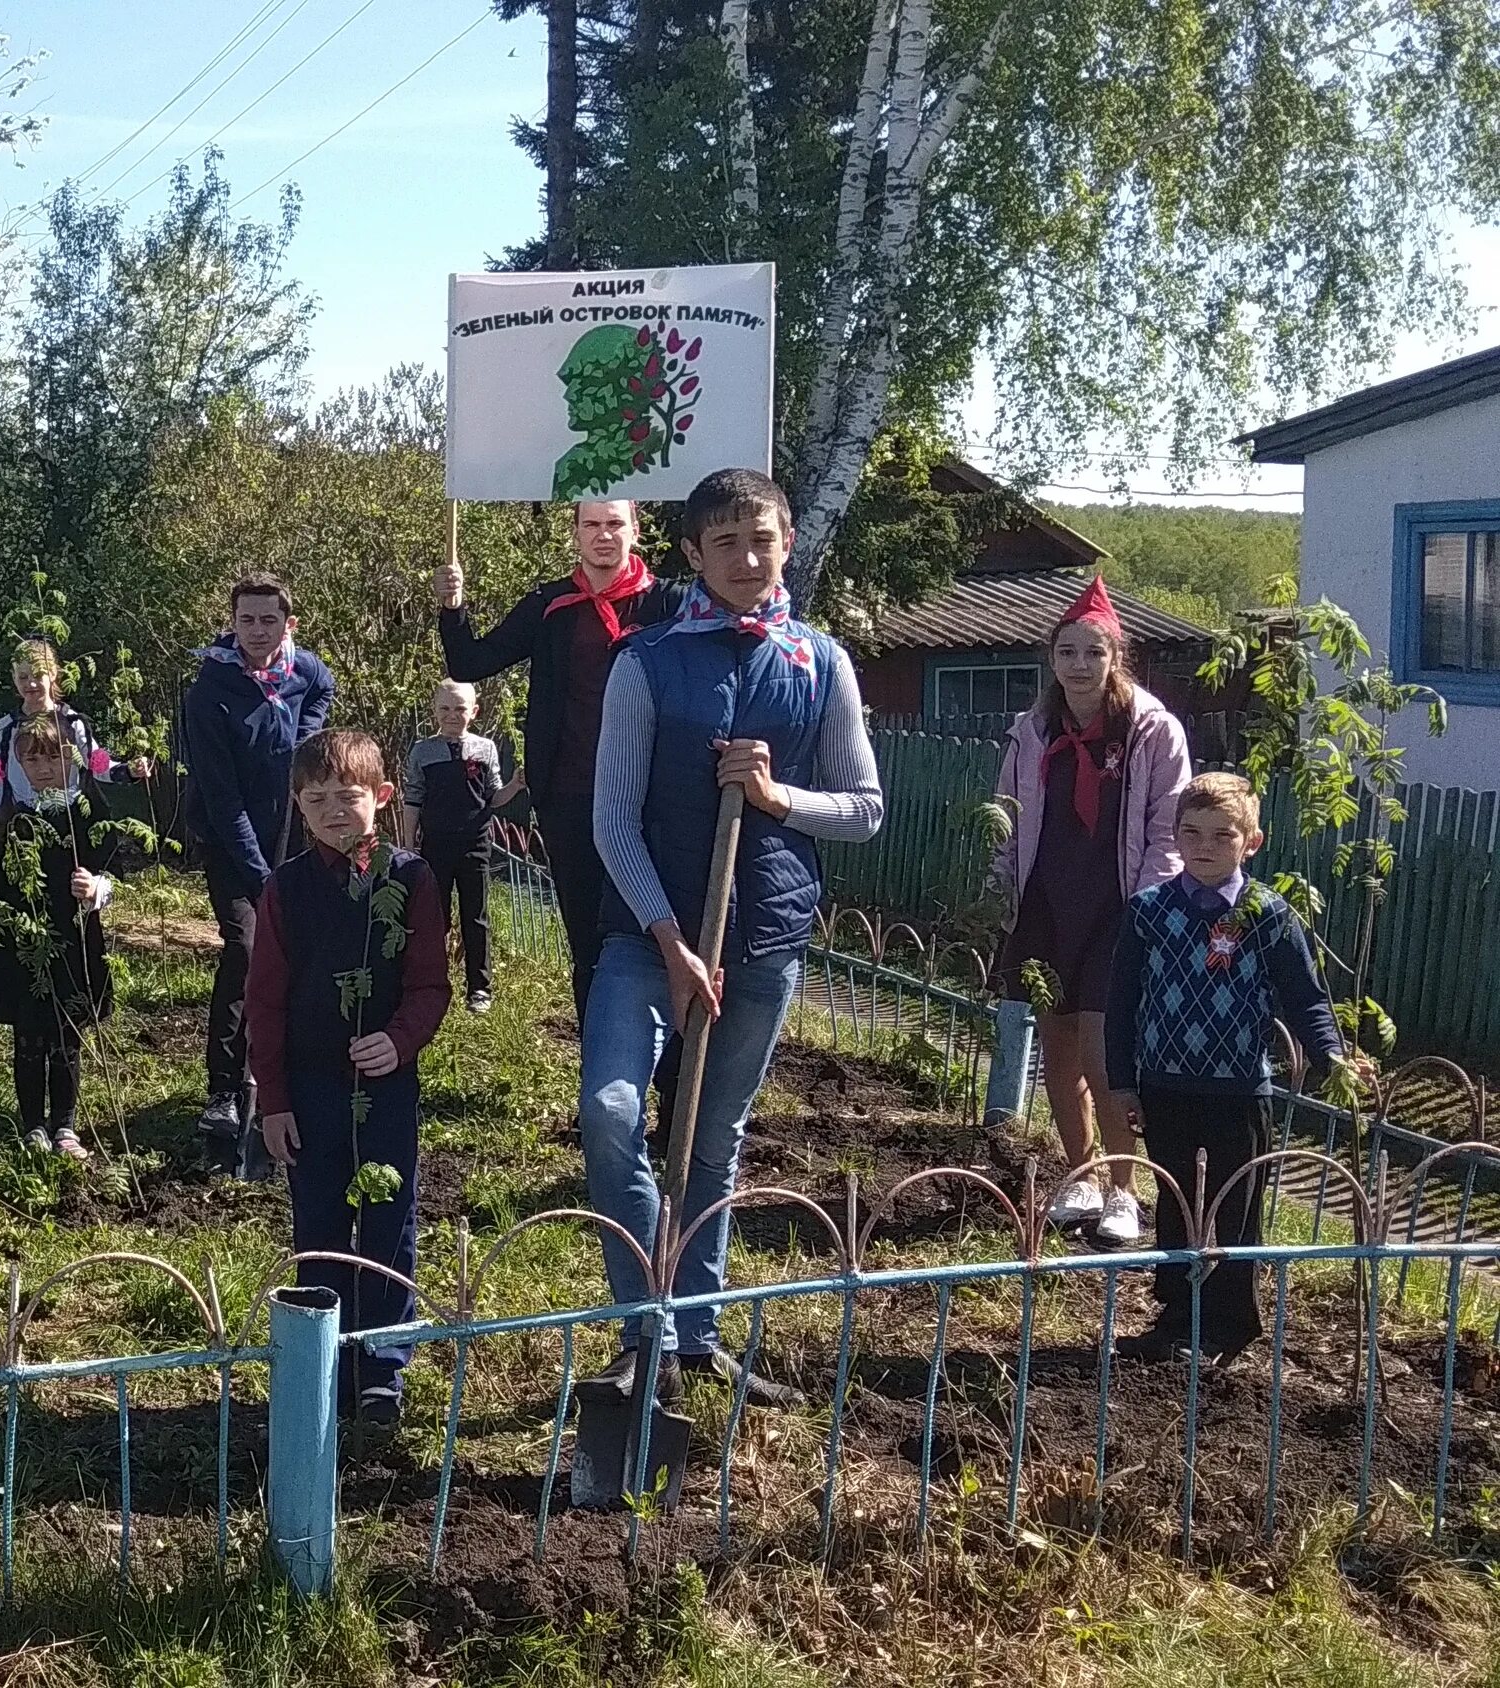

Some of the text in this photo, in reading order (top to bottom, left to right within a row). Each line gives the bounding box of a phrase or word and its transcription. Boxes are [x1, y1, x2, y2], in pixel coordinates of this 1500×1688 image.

[572, 279, 645, 298] АКЦИЯ
[452, 304, 766, 338] "ЗЕЛЕНЫЙ ОСТРОВОК ПАМЯТИ"
